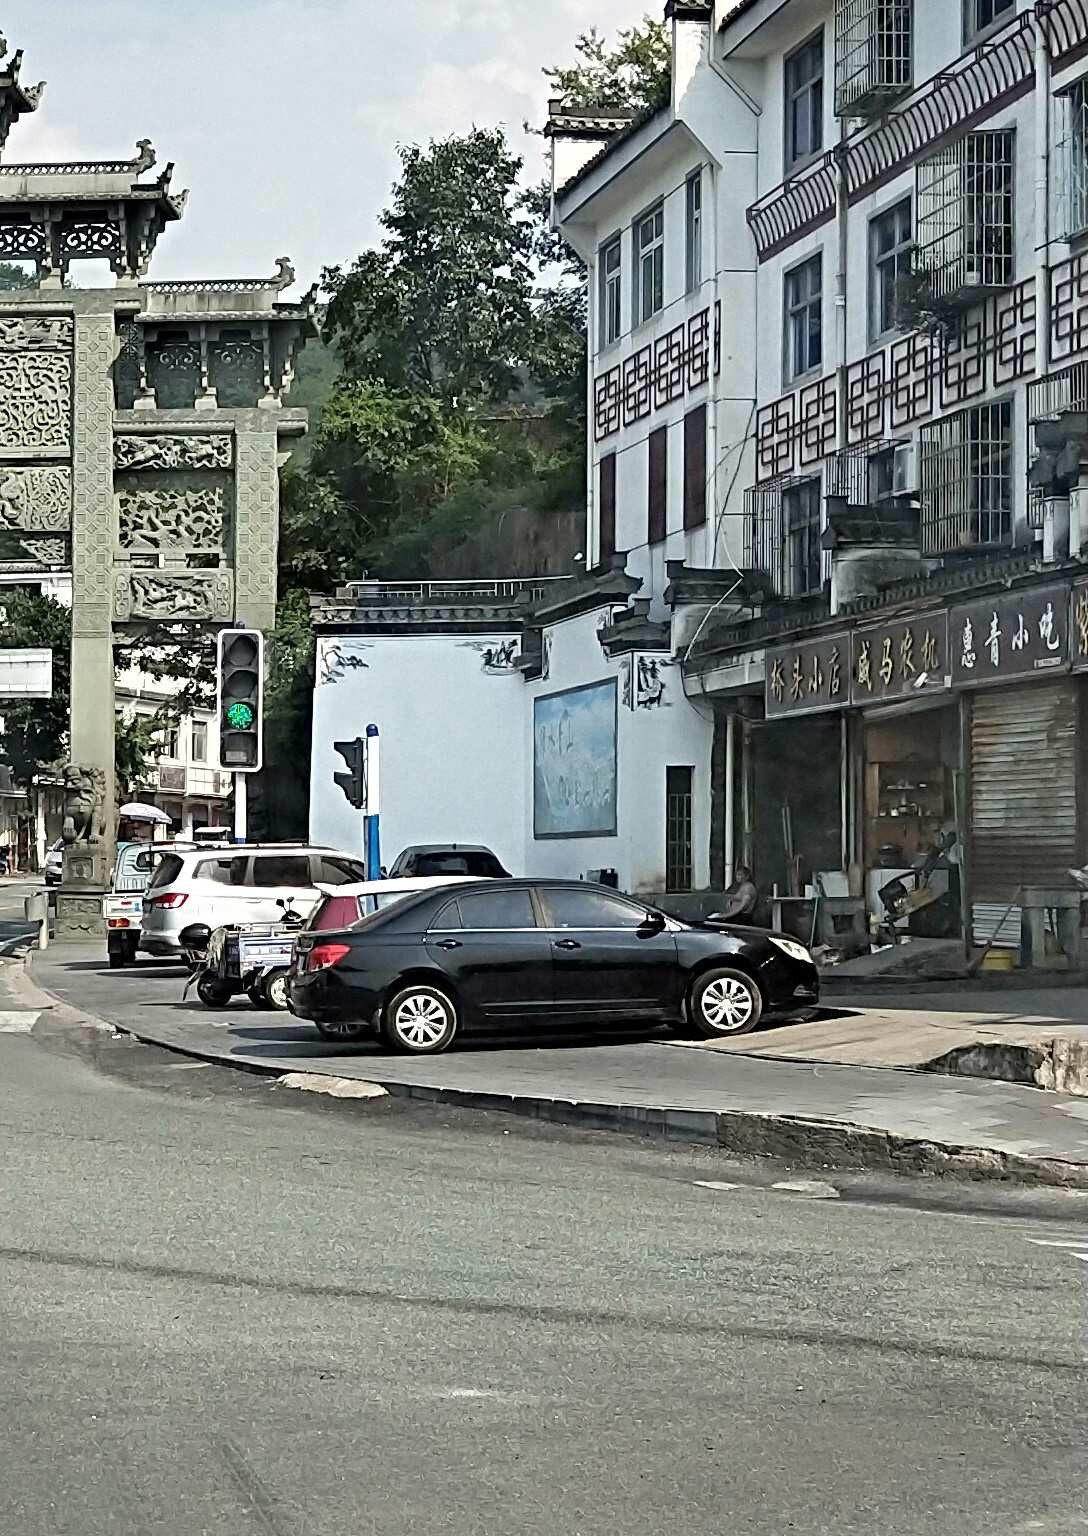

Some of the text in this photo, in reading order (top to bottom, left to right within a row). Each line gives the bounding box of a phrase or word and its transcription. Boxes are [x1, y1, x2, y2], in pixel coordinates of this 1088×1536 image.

[770, 646, 842, 704] 桥头小店
[858, 627, 940, 692] 威马农机
